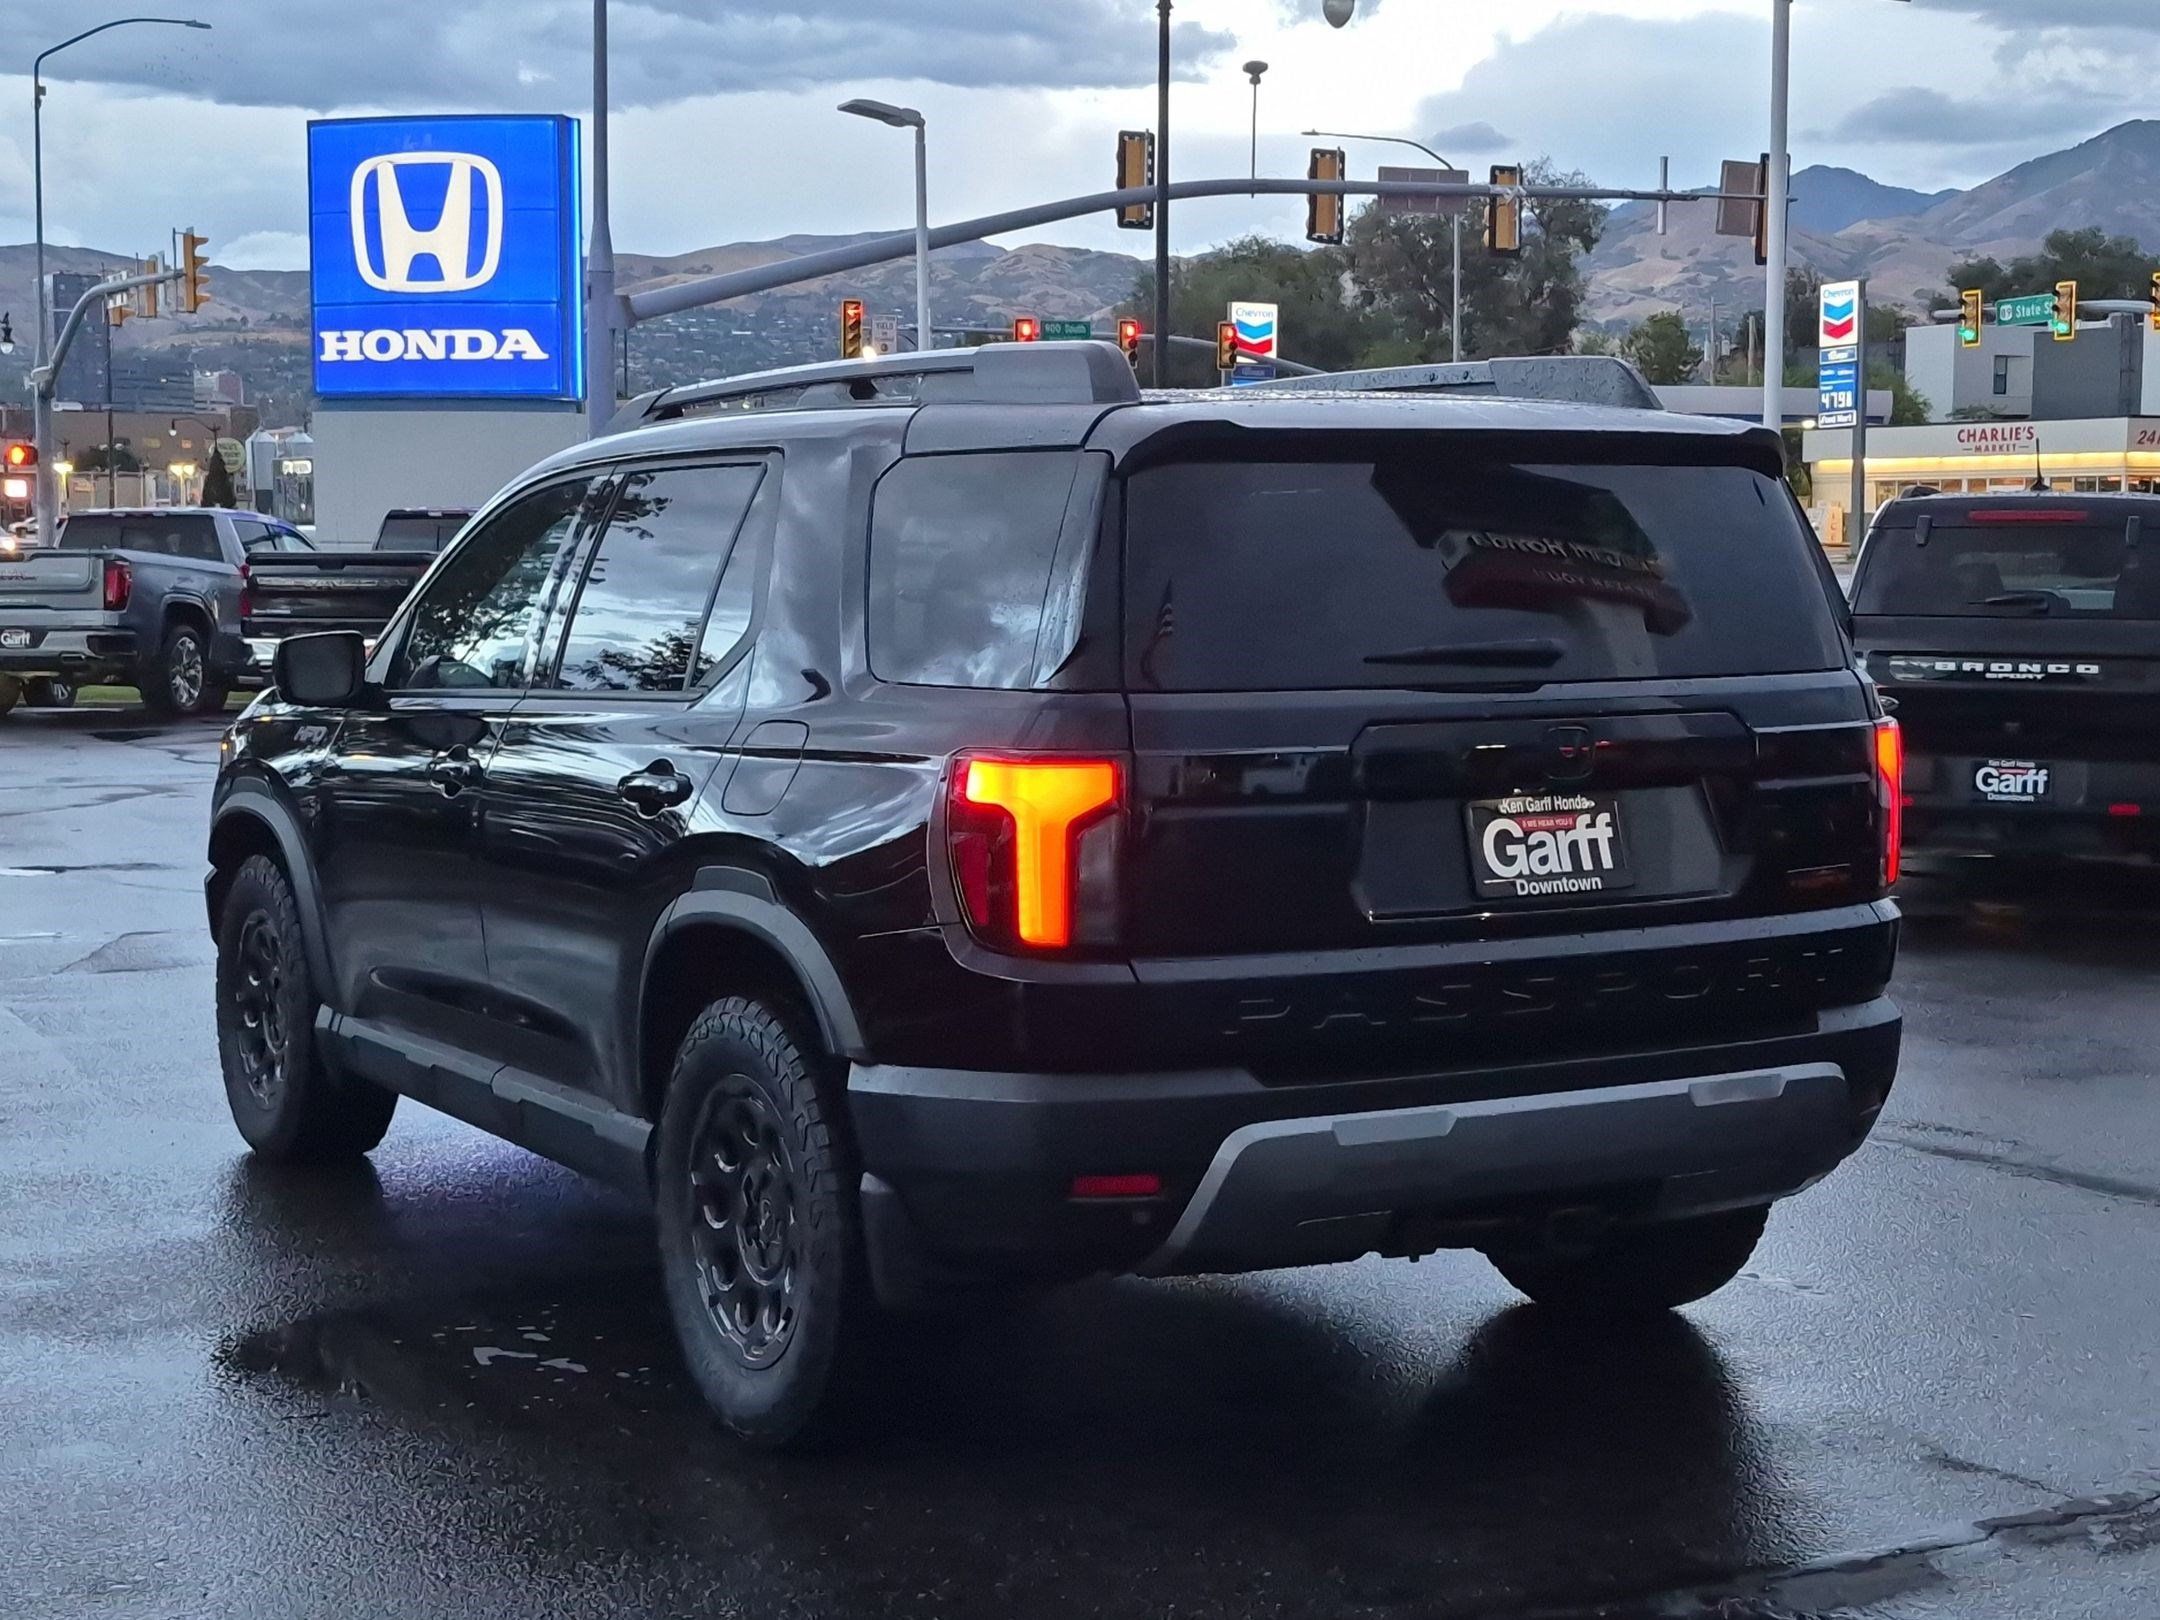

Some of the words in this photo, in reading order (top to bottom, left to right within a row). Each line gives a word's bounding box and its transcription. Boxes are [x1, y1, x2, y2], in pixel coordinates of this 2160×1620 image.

[1236, 308, 1274, 318] Chevron
[2015, 304, 2040, 318] State
[319, 328, 550, 362] HONDA
[1957, 426, 2035, 443] CHARLIE'S
[1974, 443, 2017, 453] MARKET
[1935, 662, 2099, 674] BRONCO
[1976, 767, 2048, 794] Garff
[1502, 799, 1524, 813] Ken
[1525, 796, 1552, 812] Garff
[1553, 794, 1588, 811] Honda
[1483, 813, 1614, 878] Garff
[1516, 876, 1602, 896] Downtown
[1222, 948, 1844, 1035] PASSPORT
